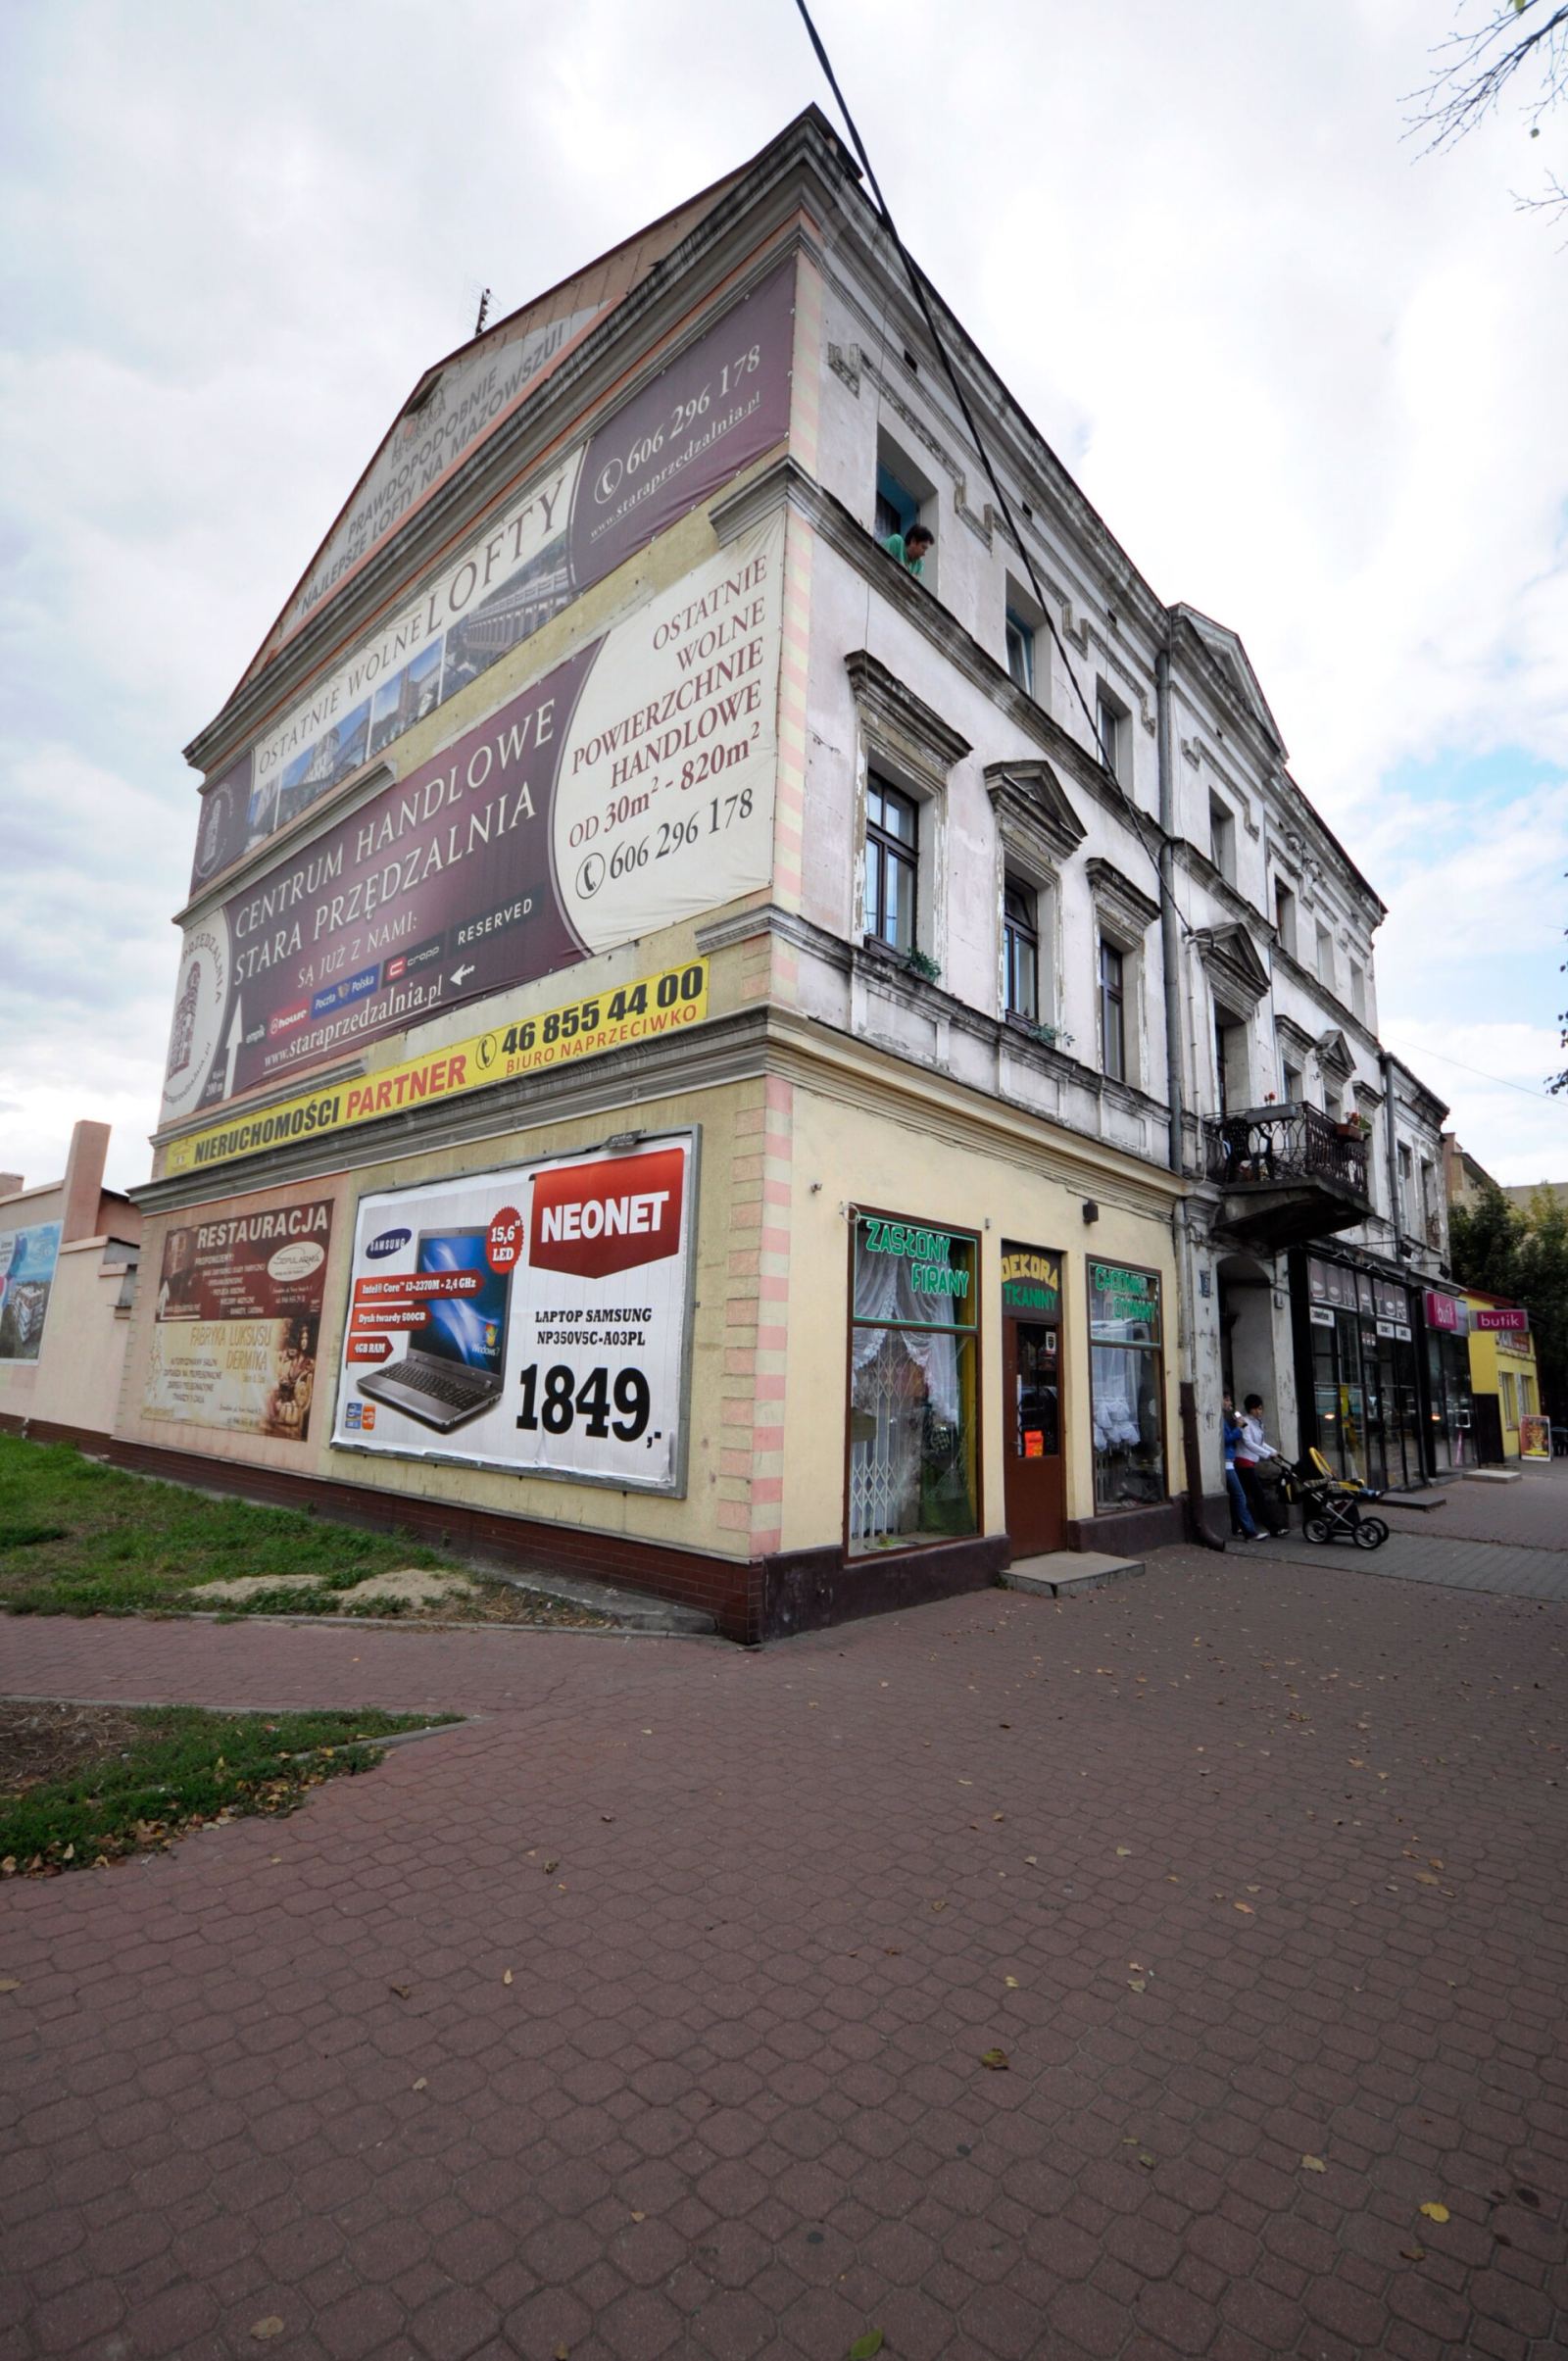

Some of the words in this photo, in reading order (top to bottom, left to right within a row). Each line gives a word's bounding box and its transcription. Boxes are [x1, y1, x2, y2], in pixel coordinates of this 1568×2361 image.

[626, 423, 664, 474] 606
[669, 383, 711, 441] 296
[719, 344, 760, 398] 178
[300, 537, 367, 615] NAJLEPSZE
[371, 481, 416, 541] LOFTY
[420, 454, 444, 488] NA
[450, 328, 564, 460] MAZOWSZU!
[348, 367, 497, 542] PRAWDOPODOBNIE
[259, 687, 340, 775] OSTATNIE
[347, 620, 422, 698] WOLNE
[425, 473, 568, 639] LOFTY
[652, 553, 767, 652] OSTATNIE
[675, 596, 766, 672] WOLNE
[571, 636, 764, 775] POWIERZCHNIE
[610, 679, 761, 791] HANDLOWE
[235, 841, 344, 940] CENTRUM
[355, 698, 556, 864] HANDLOWE
[568, 814, 600, 849] OD
[609, 834, 650, 881] 606
[655, 811, 701, 861] 296
[708, 787, 754, 836] 178
[233, 926, 303, 987] STARA
[313, 780, 537, 943] PRZĘDZALNIA
[457, 896, 534, 947] RESERVED
[297, 963, 315, 990] SĄ
[319, 945, 346, 984] JUŻ
[351, 936, 362, 963] Z
[367, 909, 418, 955] NAMI:
[407, 945, 441, 967] cropp
[315, 992, 336, 1010] Poczta
[351, 974, 375, 994] Polska
[501, 1023, 537, 1055] 46
[542, 1000, 600, 1041] 855
[606, 984, 649, 1023] 44
[658, 964, 704, 1005] 00
[264, 973, 443, 1069] www.staraprzedzalnia.pl
[506, 1045, 556, 1075] BIURO
[559, 1003, 698, 1061] NAPRZECIWKO
[194, 1097, 339, 1165] NIERUCHOMOŚCI
[346, 1053, 467, 1119] PARTNER
[197, 1205, 328, 1250] RESTAURACJA
[540, 1191, 669, 1244] NEONET
[369, 1238, 406, 1252] SAMSUNG
[492, 1247, 514, 1261] LED
[865, 1220, 951, 1264] ZASŁONY
[406, 1279, 440, 1292] i3-2370M
[445, 1278, 458, 1292] 2,4
[459, 1277, 476, 1289] GHz
[911, 1262, 969, 1299] FIRANY
[1002, 1254, 1058, 1292] DEKORA
[1003, 1283, 1057, 1311] TKANINY
[190, 1324, 226, 1348] FABRYKA
[229, 1324, 272, 1348] LUKSUSU
[359, 1313, 375, 1324] Dysk
[376, 1312, 401, 1324] twardy
[402, 1311, 426, 1322] 500GB
[535, 1309, 583, 1323] LAPTOP
[585, 1308, 653, 1323] SAMSUNG
[536, 1331, 647, 1347] NP350V5C-A03PL
[1481, 1313, 1520, 1327] butik
[225, 1350, 269, 1371] DERMIKA
[355, 1344, 368, 1353] 4GB
[368, 1343, 386, 1353] RAM
